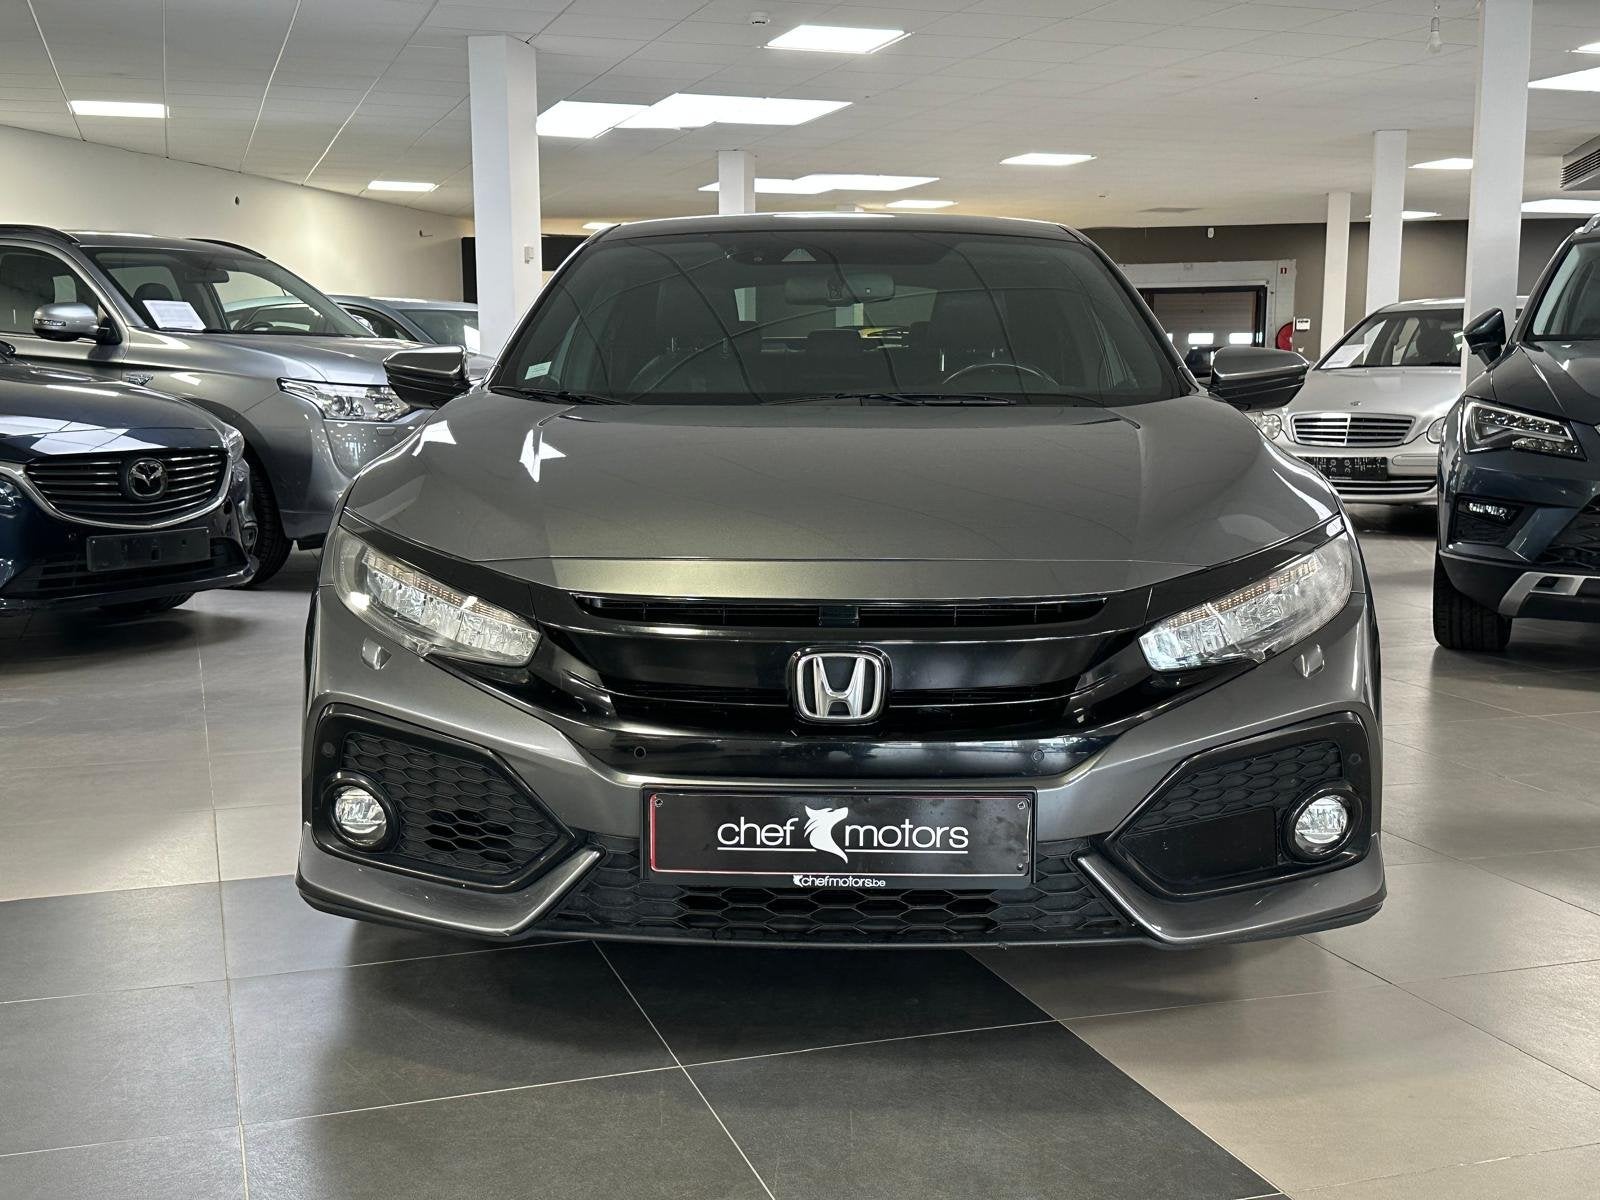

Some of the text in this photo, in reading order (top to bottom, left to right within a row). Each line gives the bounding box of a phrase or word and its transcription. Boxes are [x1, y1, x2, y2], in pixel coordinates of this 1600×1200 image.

[717, 816, 969, 848] chef motors
[801, 875, 886, 888] chefmotors.be
